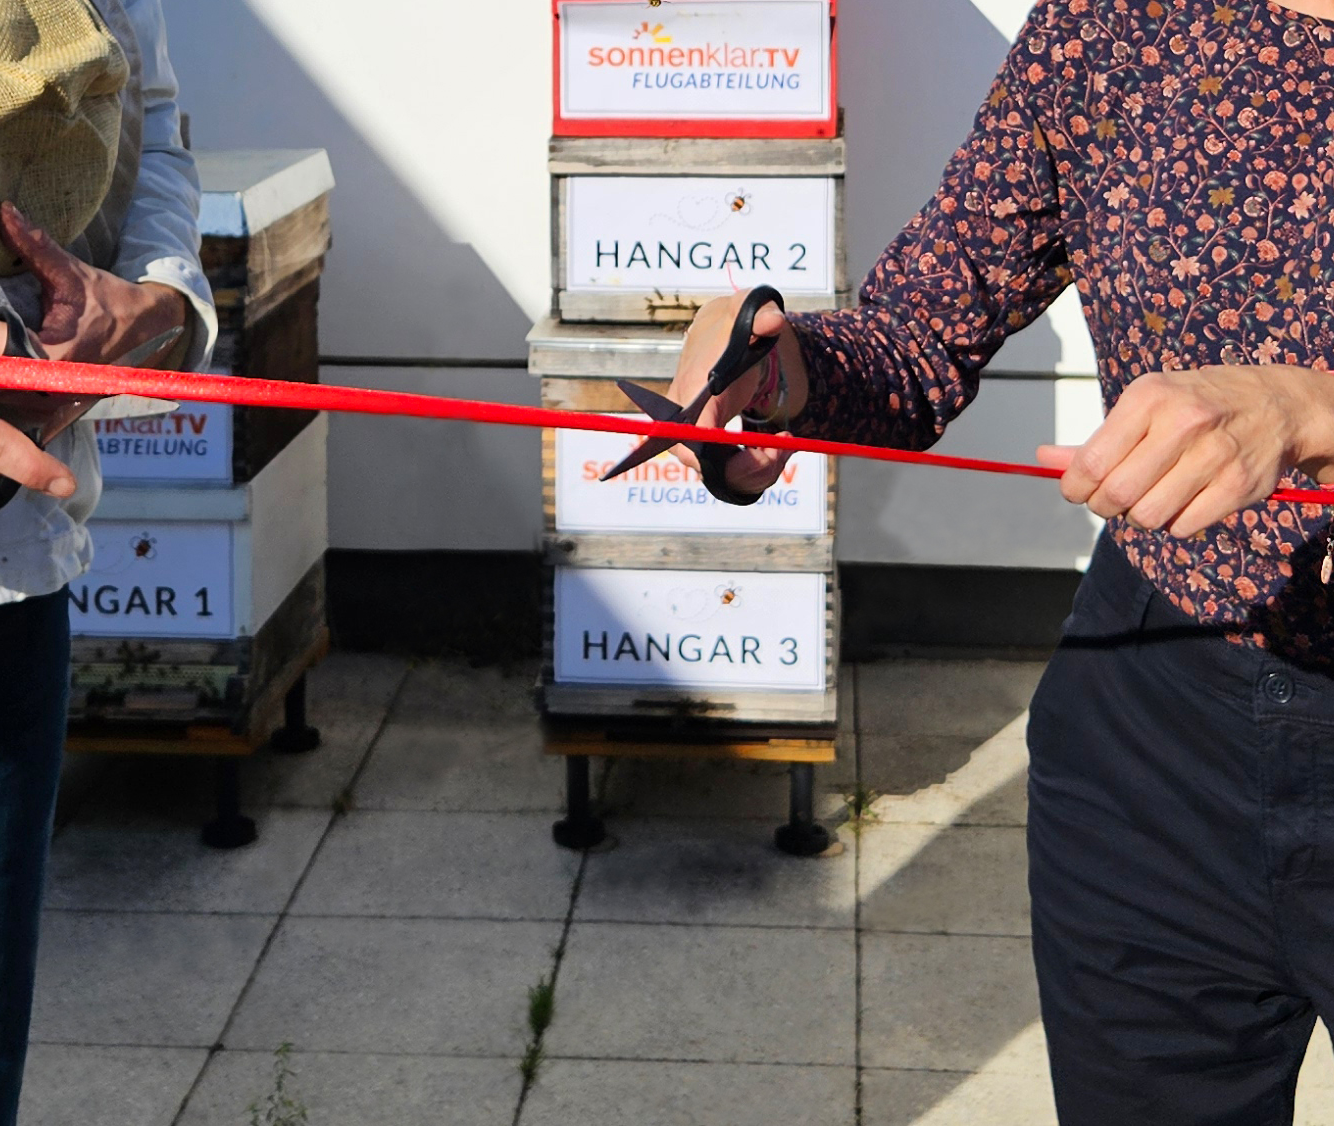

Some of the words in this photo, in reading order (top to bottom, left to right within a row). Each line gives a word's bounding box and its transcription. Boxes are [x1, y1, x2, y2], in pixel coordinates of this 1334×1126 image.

[587, 43, 800, 69] sonnenklar.TV
[632, 72, 800, 90] FLUGABTEILUNG
[595, 240, 770, 271] HANGAR
[787, 242, 807, 271] 2
[94, 412, 208, 435] nklar.TV
[97, 438, 208, 456] ABTEILUNG
[67, 584, 178, 617] NGAR
[195, 586, 213, 616] 1
[582, 629, 762, 665] HANGAR
[778, 637, 799, 666] 3
